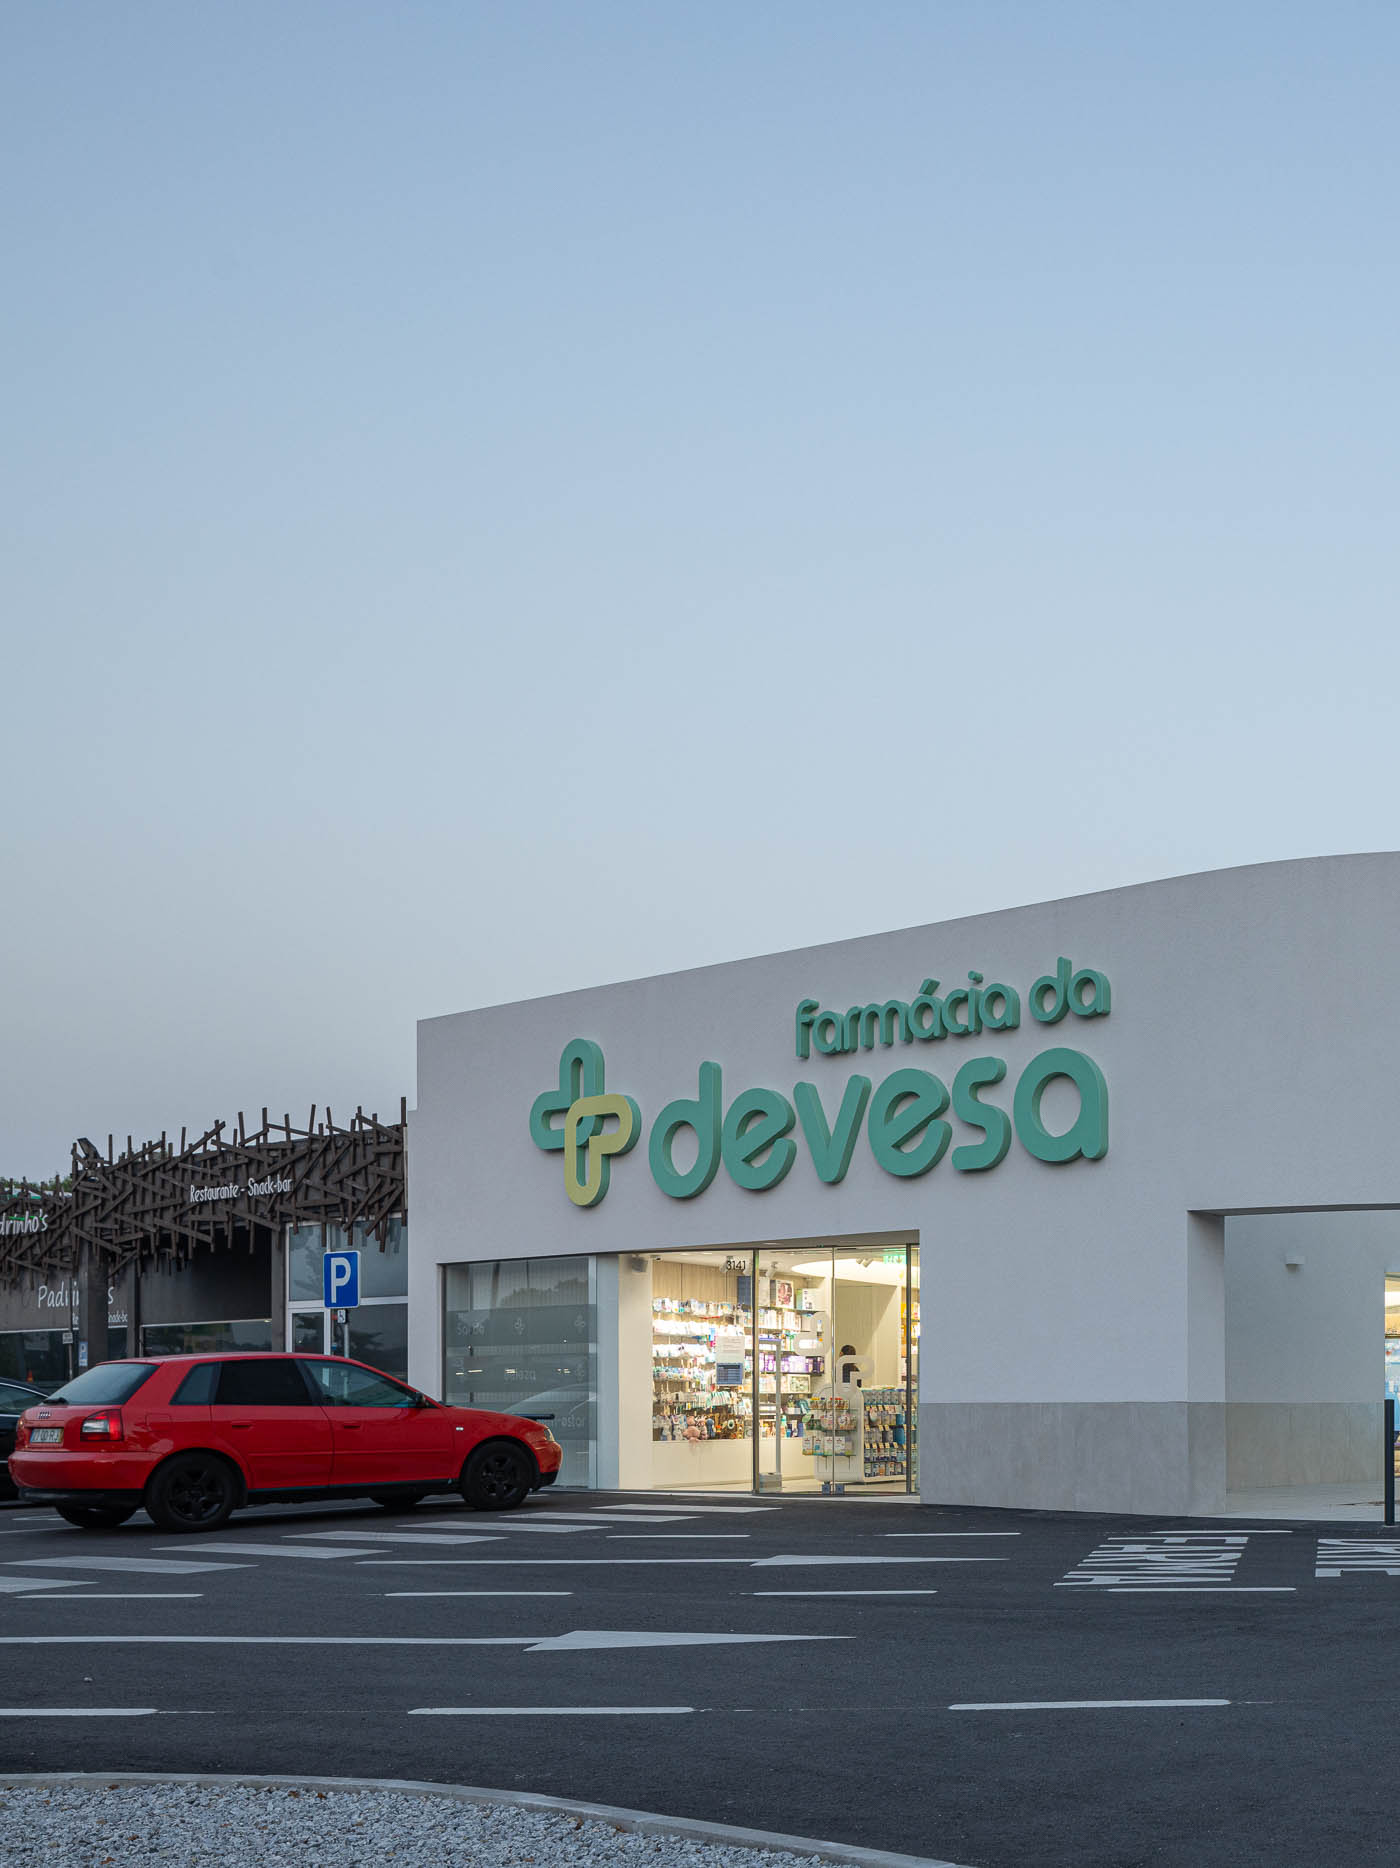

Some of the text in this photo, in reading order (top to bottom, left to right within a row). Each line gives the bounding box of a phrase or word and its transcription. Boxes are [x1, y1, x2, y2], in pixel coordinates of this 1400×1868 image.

[796, 956, 1112, 1058] farmácia da
[649, 1047, 1109, 1199] devesa
[190, 1182, 239, 1203] Restaurante
[248, 1173, 293, 1197] Snack-bar
[330, 1256, 351, 1303] P
[726, 1260, 746, 1271] 3141
